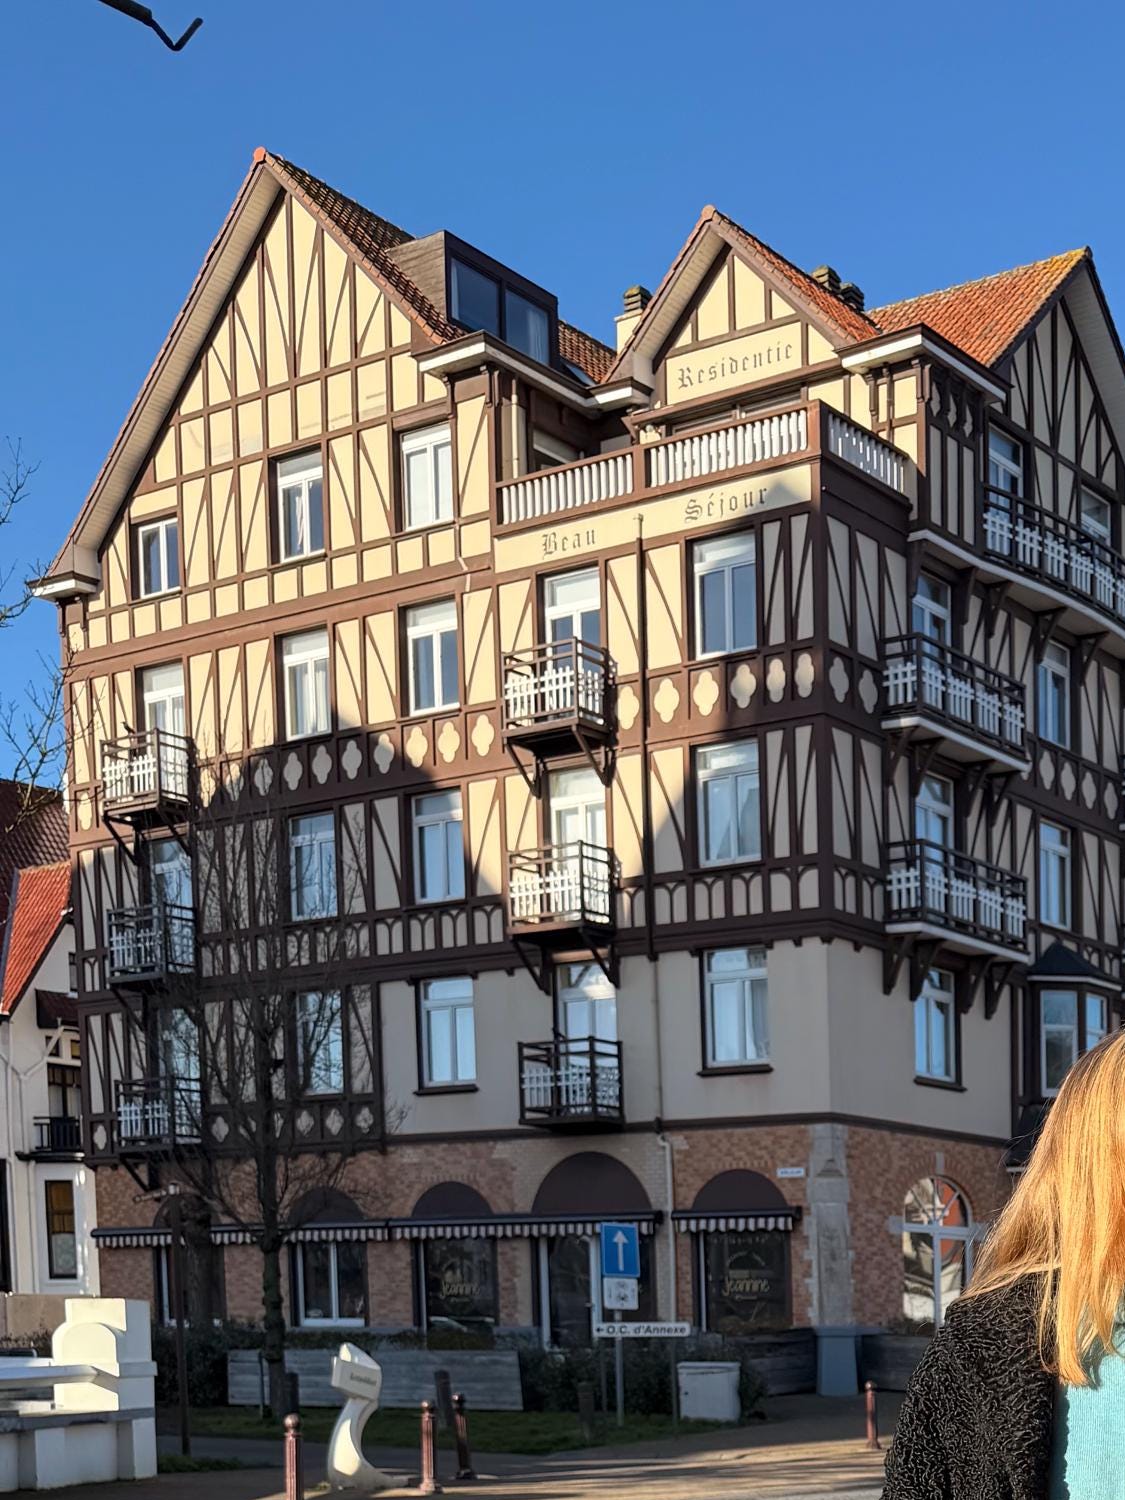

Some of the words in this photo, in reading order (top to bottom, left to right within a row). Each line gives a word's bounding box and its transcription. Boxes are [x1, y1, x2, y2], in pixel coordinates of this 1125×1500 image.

[678, 341, 793, 390] Residentie
[541, 529, 596, 557] Beau
[684, 487, 767, 524] Séjour
[607, 1324, 630, 1335] O.C.
[634, 1324, 687, 1335] d'Annexe
